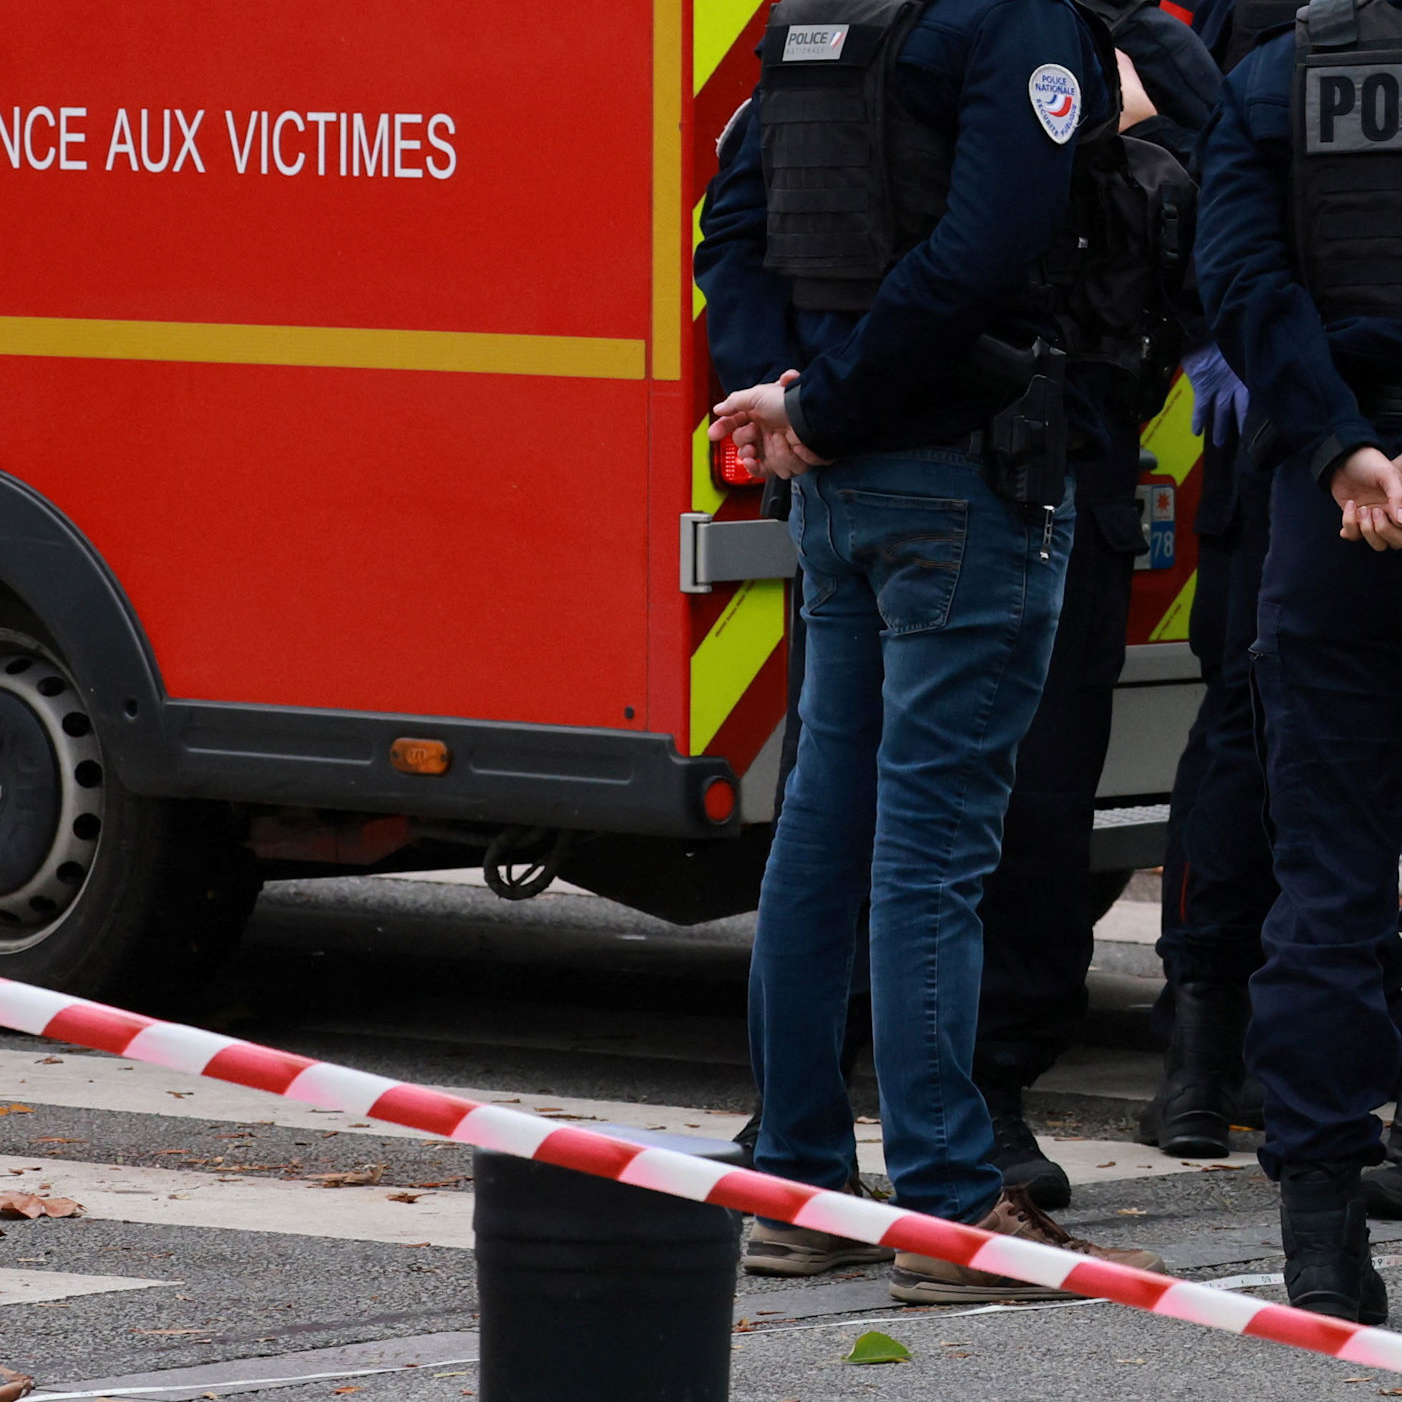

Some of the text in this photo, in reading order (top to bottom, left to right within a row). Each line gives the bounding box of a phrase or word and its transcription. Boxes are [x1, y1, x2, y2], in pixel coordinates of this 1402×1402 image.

[788, 31, 829, 46] POLICE
[1042, 74, 1067, 86] POLICE
[1035, 83, 1076, 96] NATIONALE
[104, 107, 206, 174] AUX
[225, 109, 457, 180] VICTIMES
[1152, 530, 1174, 558] 78
